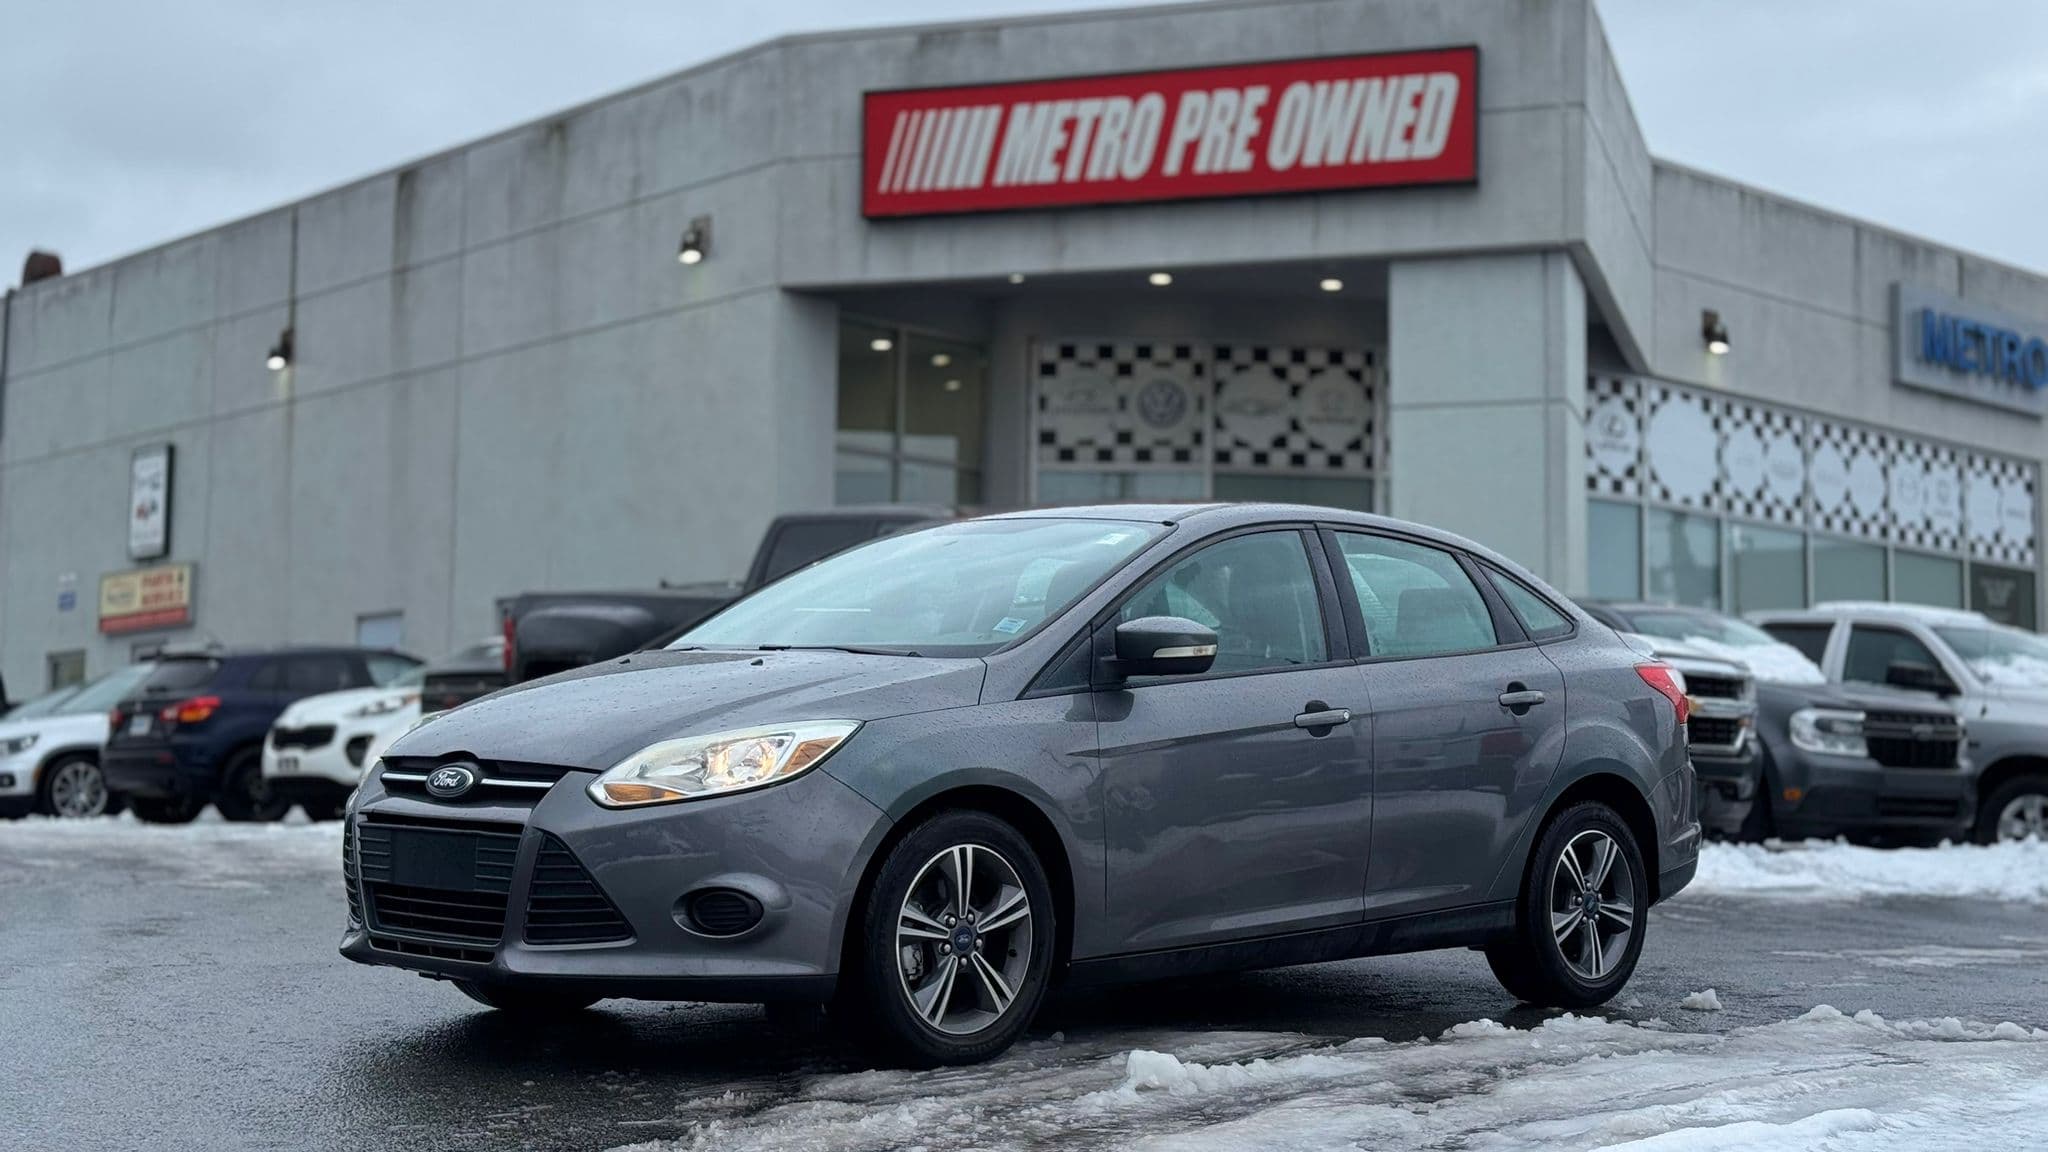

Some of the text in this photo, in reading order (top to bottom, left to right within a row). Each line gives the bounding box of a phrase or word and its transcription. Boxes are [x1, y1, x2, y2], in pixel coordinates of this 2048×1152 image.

[992, 71, 1460, 188] METRO PRE OWNED
[1921, 307, 2048, 389] METRO
[433, 770, 461, 787] Ford
